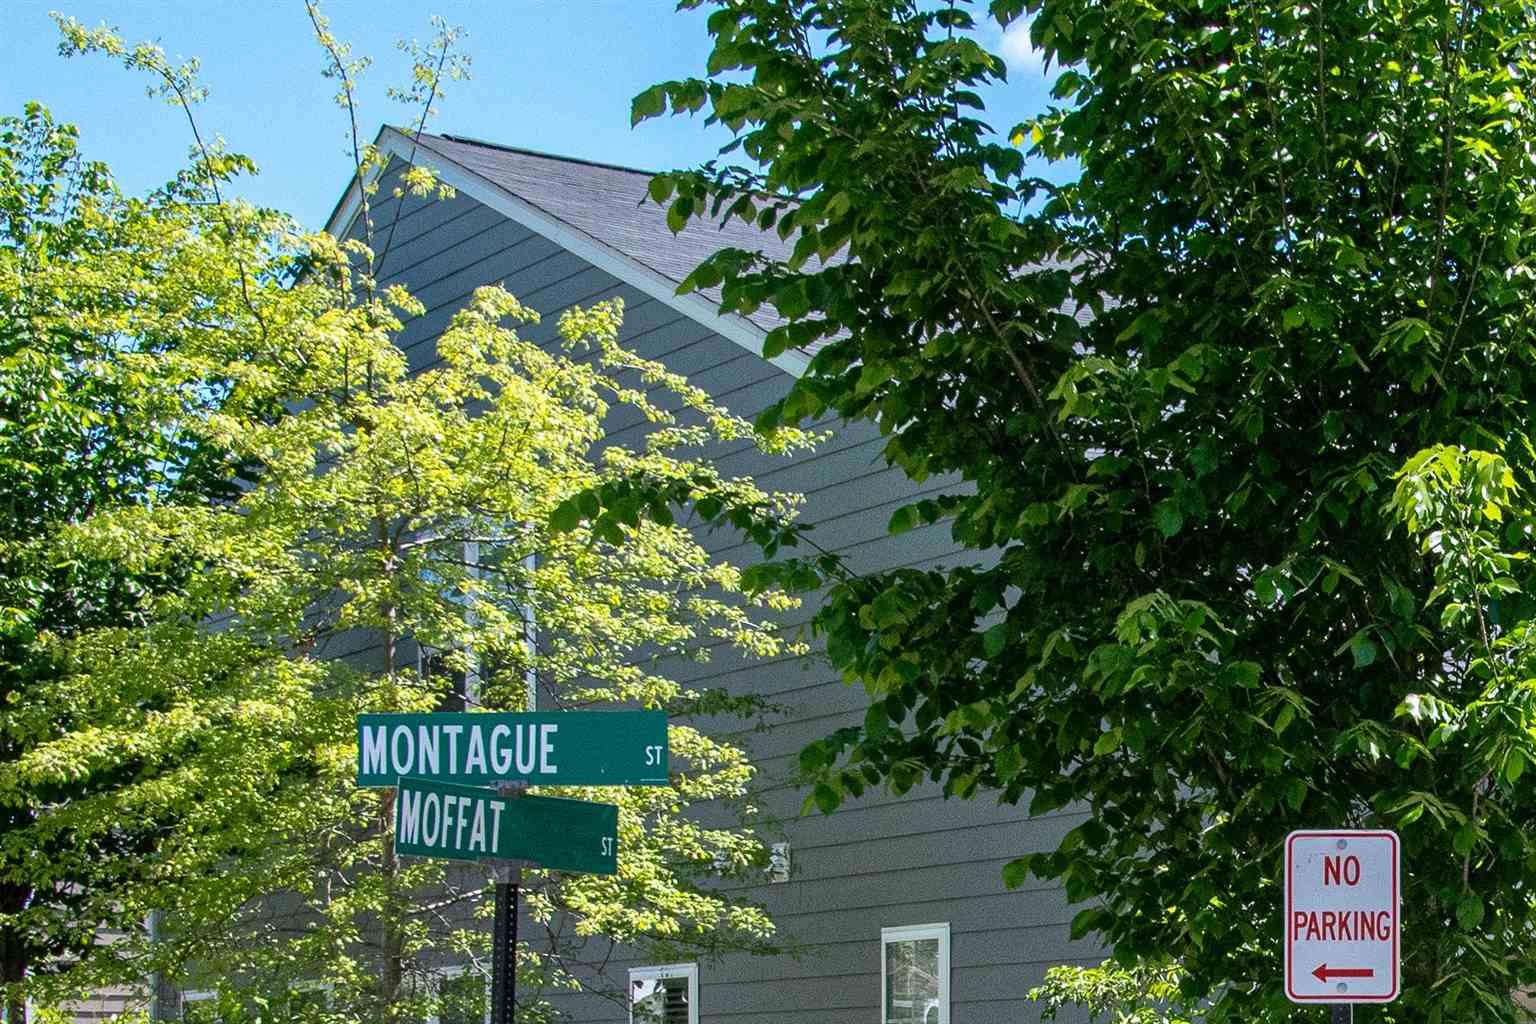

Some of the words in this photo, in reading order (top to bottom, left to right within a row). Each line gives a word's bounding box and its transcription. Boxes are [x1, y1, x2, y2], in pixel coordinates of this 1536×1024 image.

[362, 724, 558, 775] MONTAGUE
[645, 745, 663, 766] ST
[399, 790, 505, 853] MOFFAT
[601, 836, 614, 857] ST
[1324, 855, 1361, 886] NO
[1294, 910, 1391, 942] PARKING
